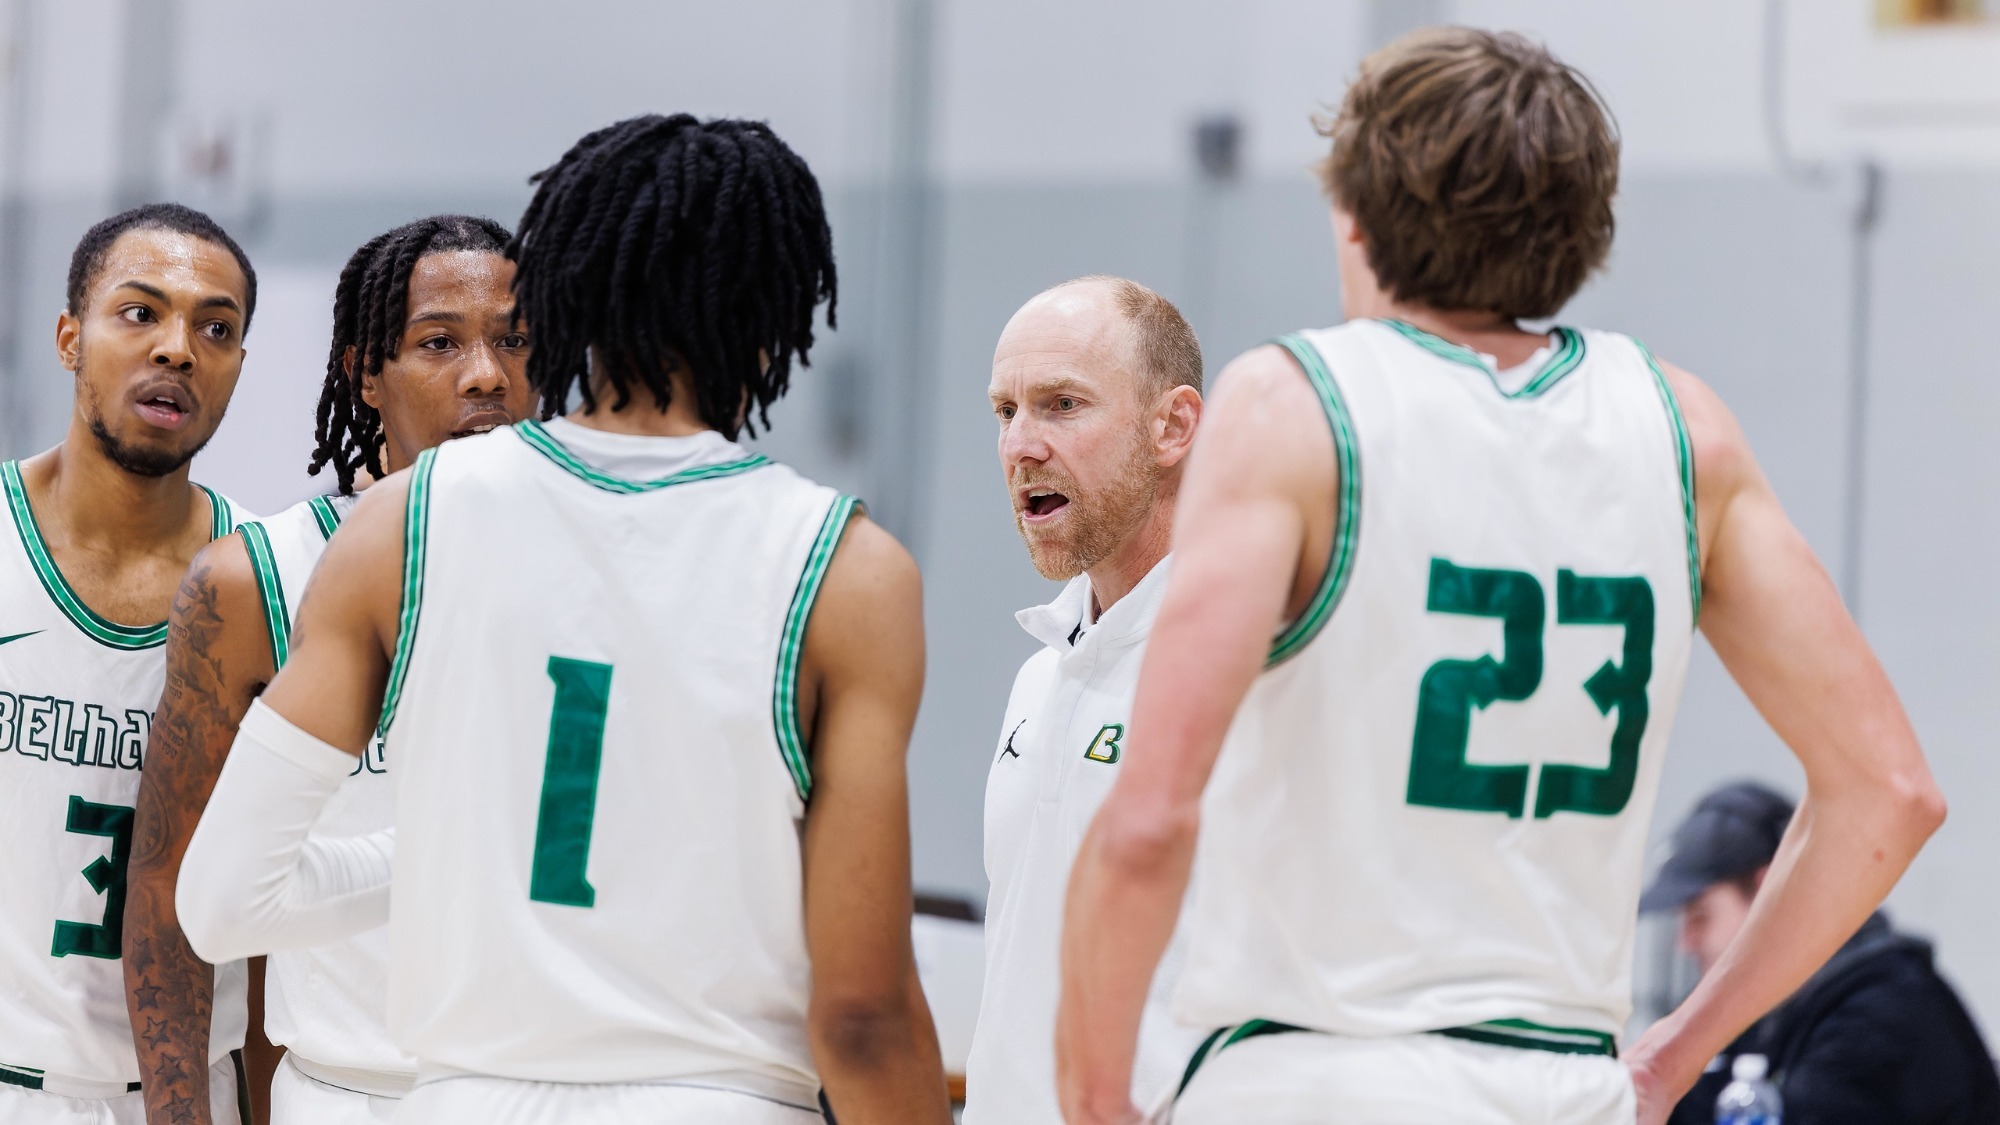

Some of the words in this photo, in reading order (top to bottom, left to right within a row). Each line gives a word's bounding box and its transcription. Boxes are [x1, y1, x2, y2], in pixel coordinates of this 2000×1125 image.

[530, 655, 613, 907] 1
[1084, 722, 1125, 764] B
[1406, 558, 1654, 819] 23
[51, 795, 135, 960] 3
